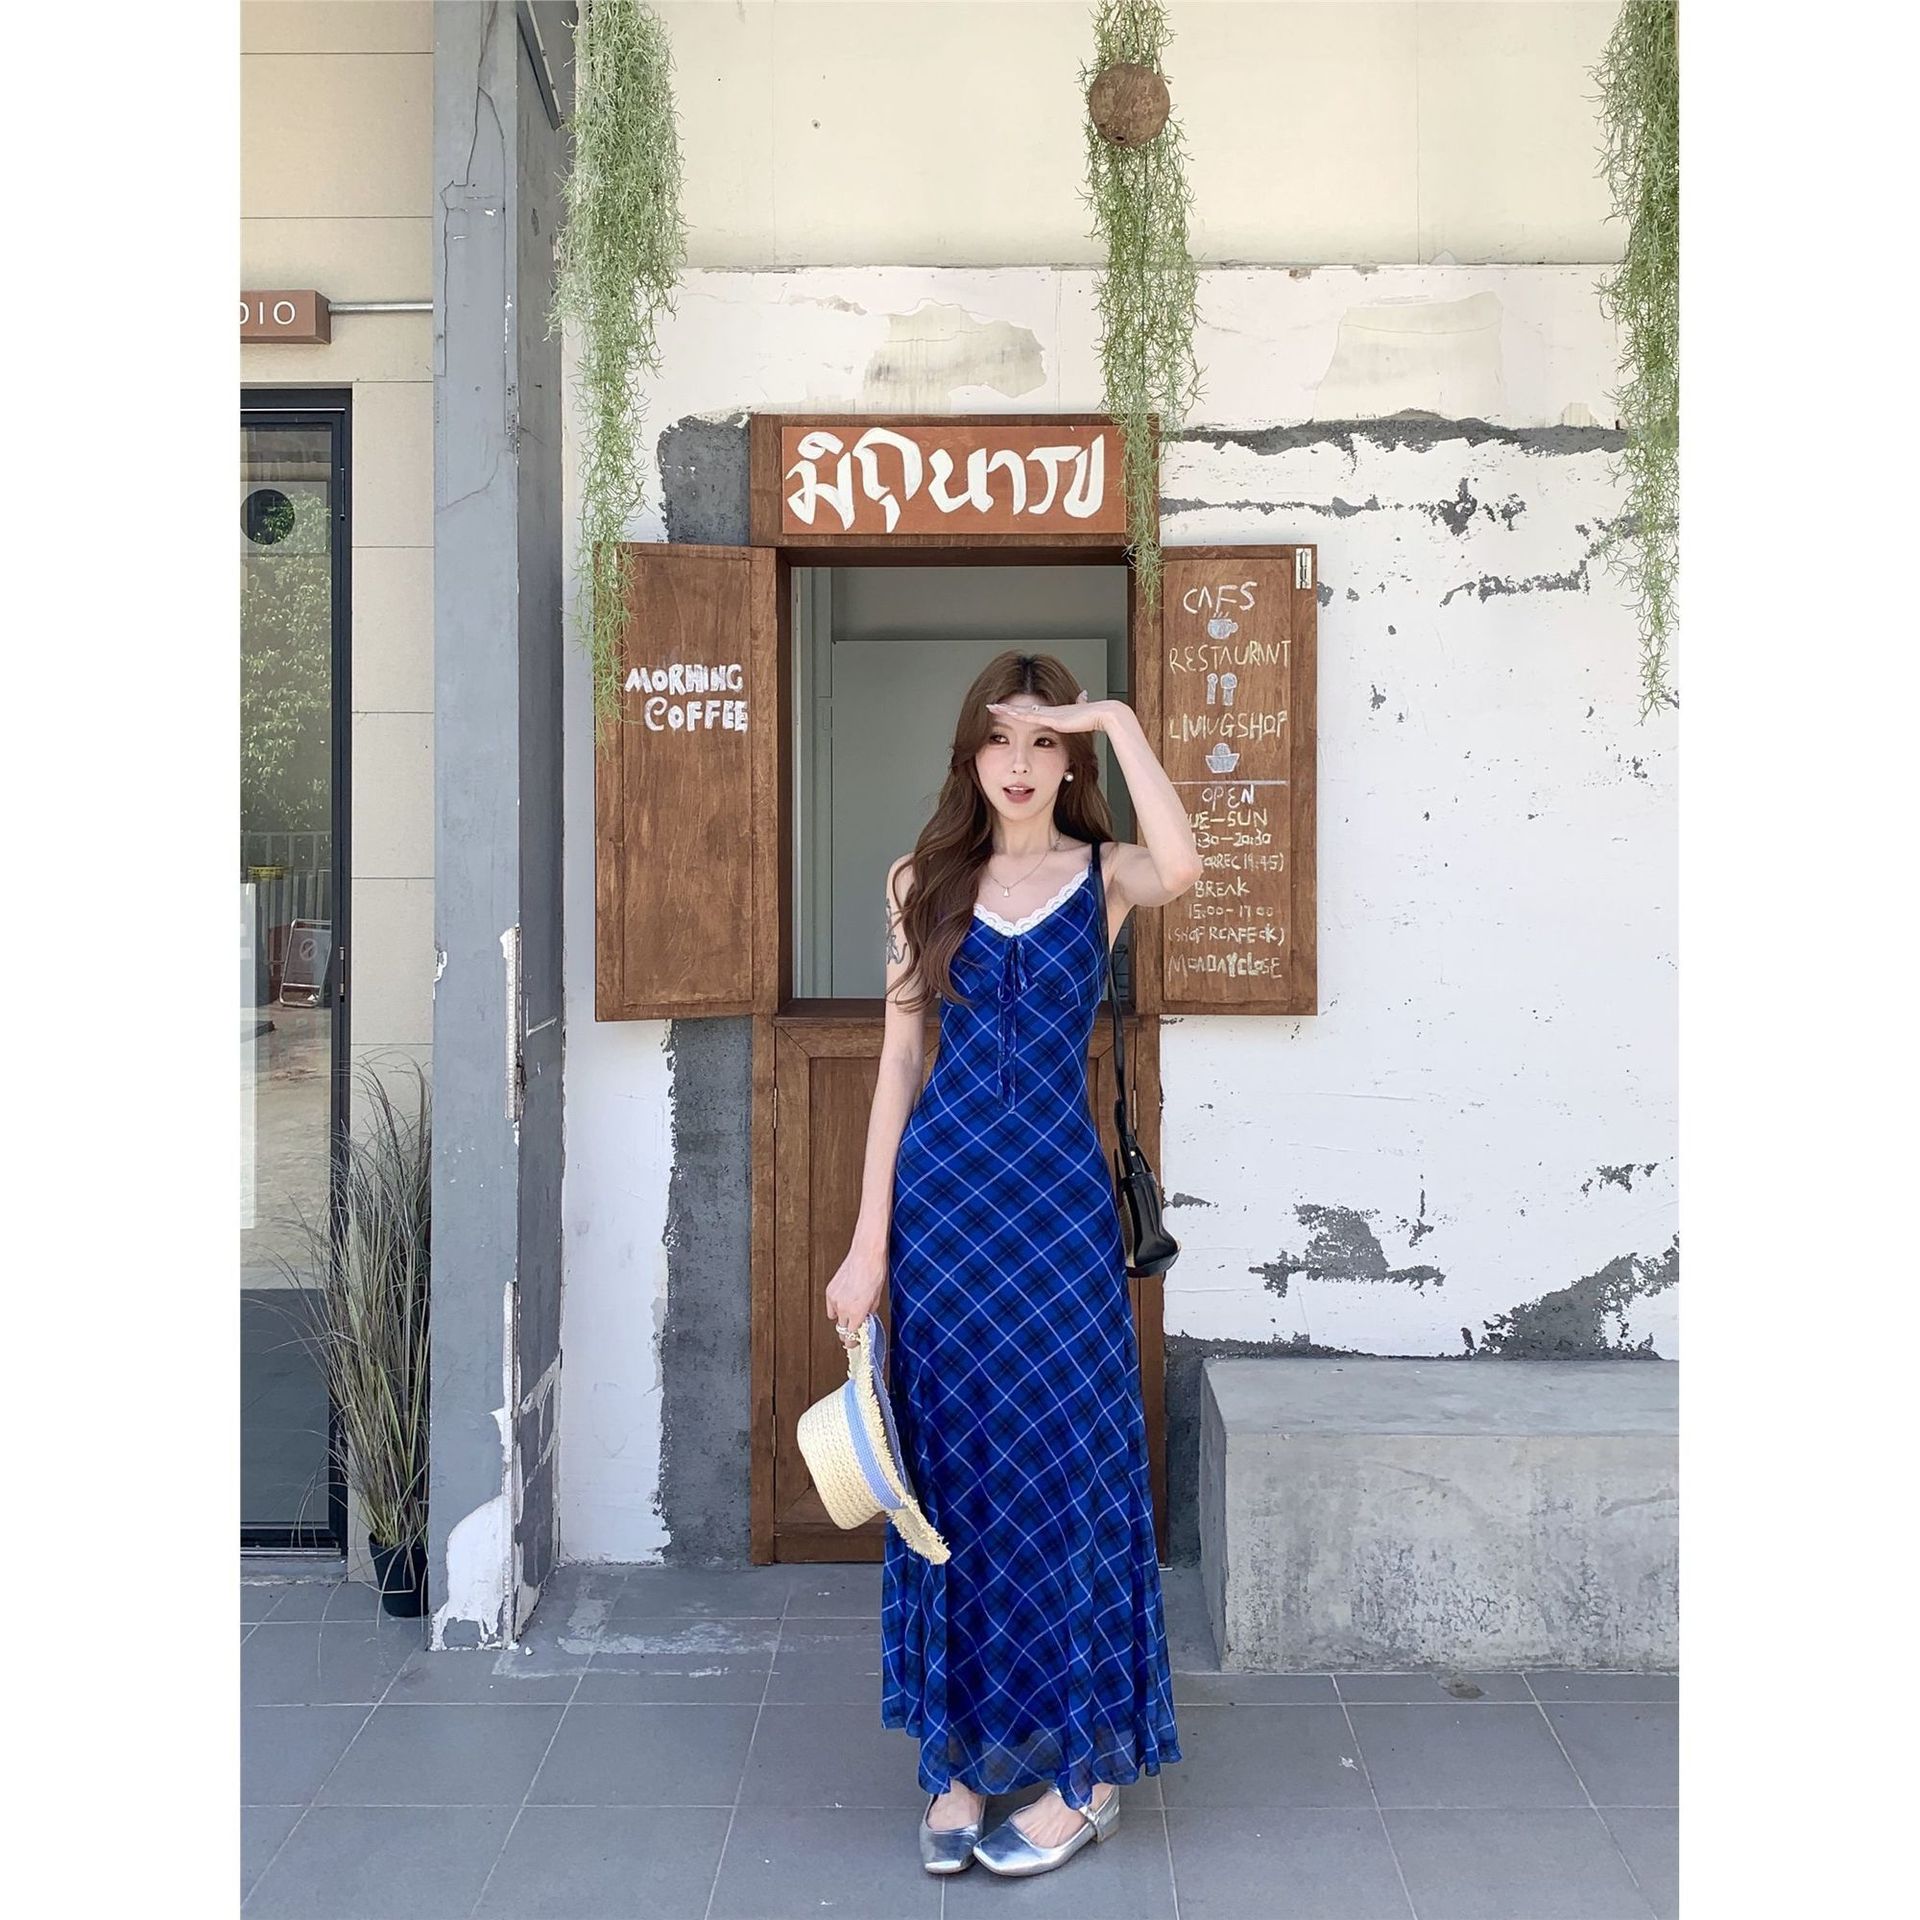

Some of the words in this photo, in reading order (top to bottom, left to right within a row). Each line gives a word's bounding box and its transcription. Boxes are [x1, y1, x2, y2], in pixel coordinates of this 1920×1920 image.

[624, 663, 744, 695] MORNING
[644, 696, 749, 733] COFFEE
[1201, 784, 1255, 811] OPEN
[1194, 876, 1251, 898] BREAK
